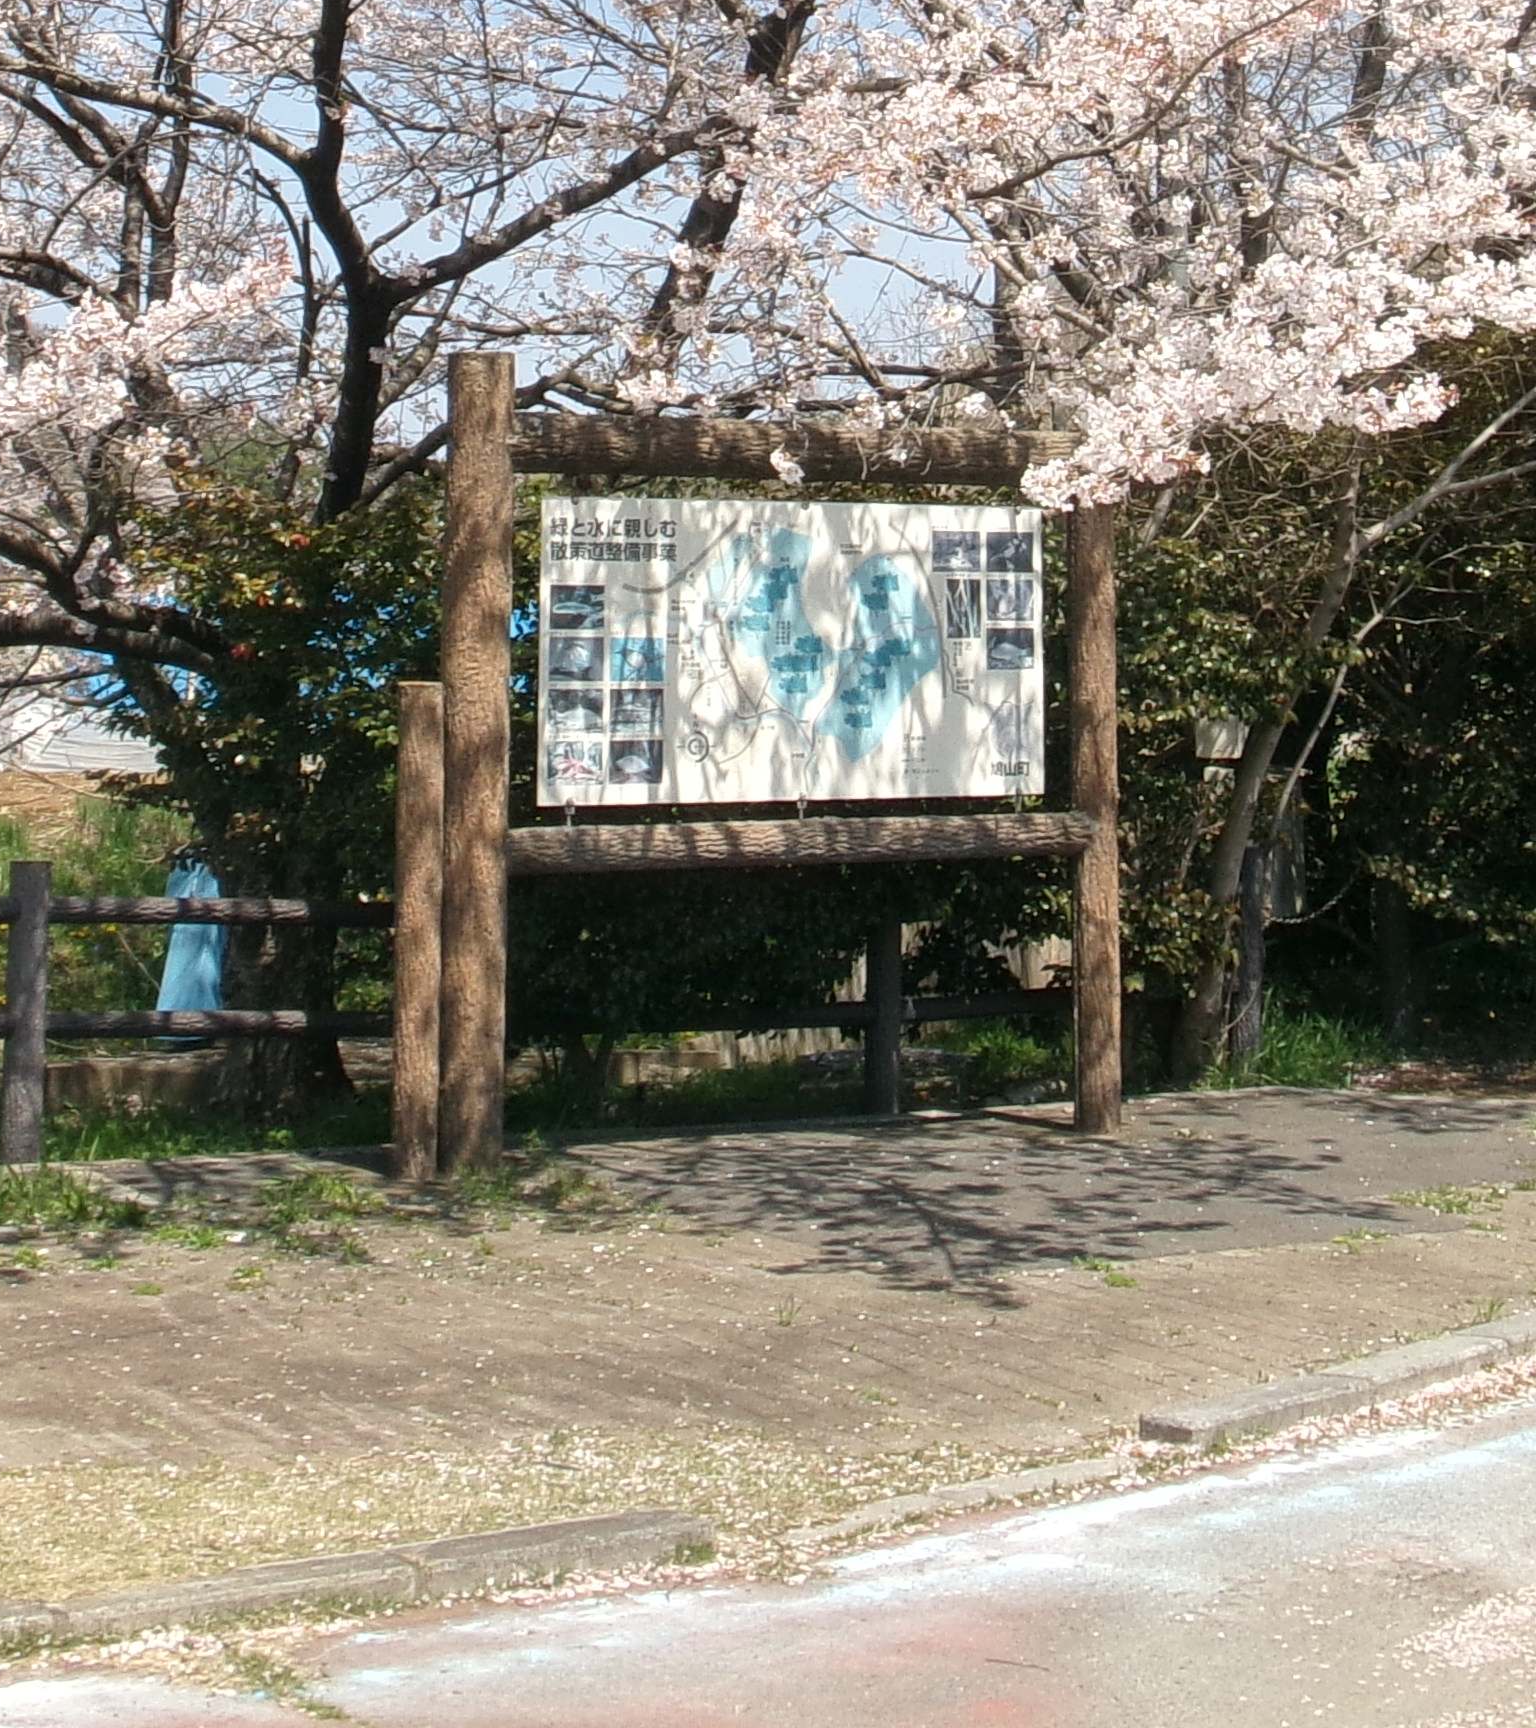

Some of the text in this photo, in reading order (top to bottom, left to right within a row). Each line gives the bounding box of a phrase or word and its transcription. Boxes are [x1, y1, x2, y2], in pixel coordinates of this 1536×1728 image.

[550, 517, 677, 538] 緑と水に親しむ
[550, 541, 677, 562] 散策道整備事業
